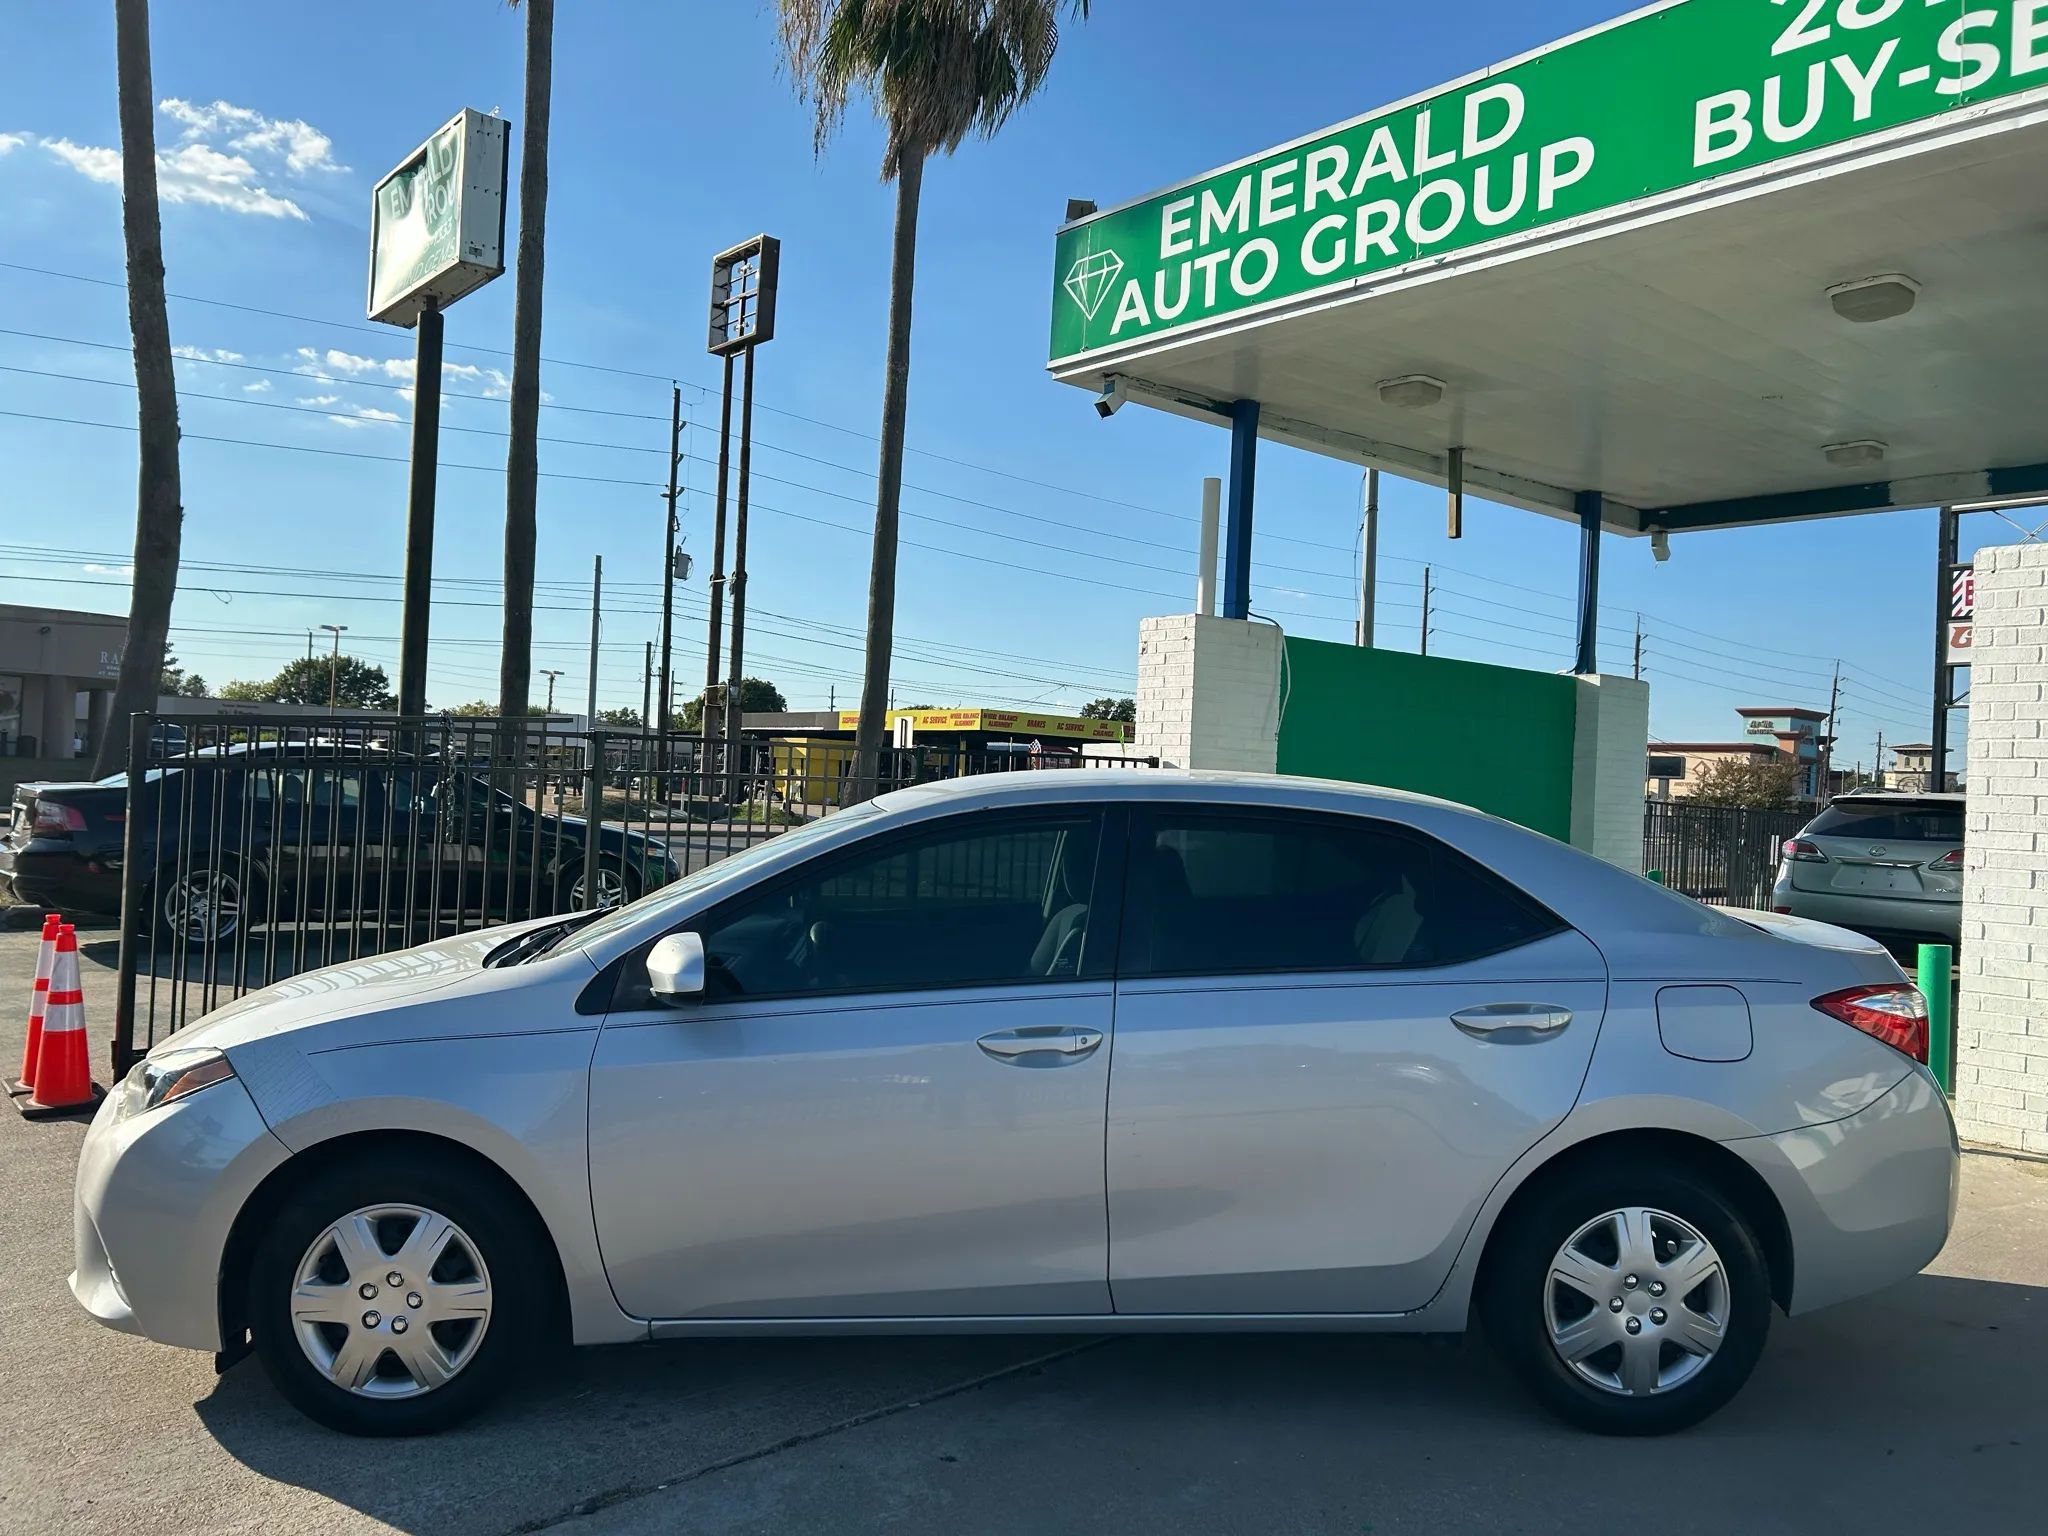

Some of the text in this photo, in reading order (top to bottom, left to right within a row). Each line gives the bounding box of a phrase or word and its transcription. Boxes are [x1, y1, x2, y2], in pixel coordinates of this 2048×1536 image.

[1160, 82, 1526, 260] EMERALD
[1109, 135, 1596, 336] AUTO GROUP
[922, 716, 930, 724] AC
[930, 716, 948, 724] SERVICE
[1026, 719, 1046, 729] BRAKES
[1056, 722, 1085, 732] AC SERVICE
[1092, 729, 1115, 738] CHANGE
